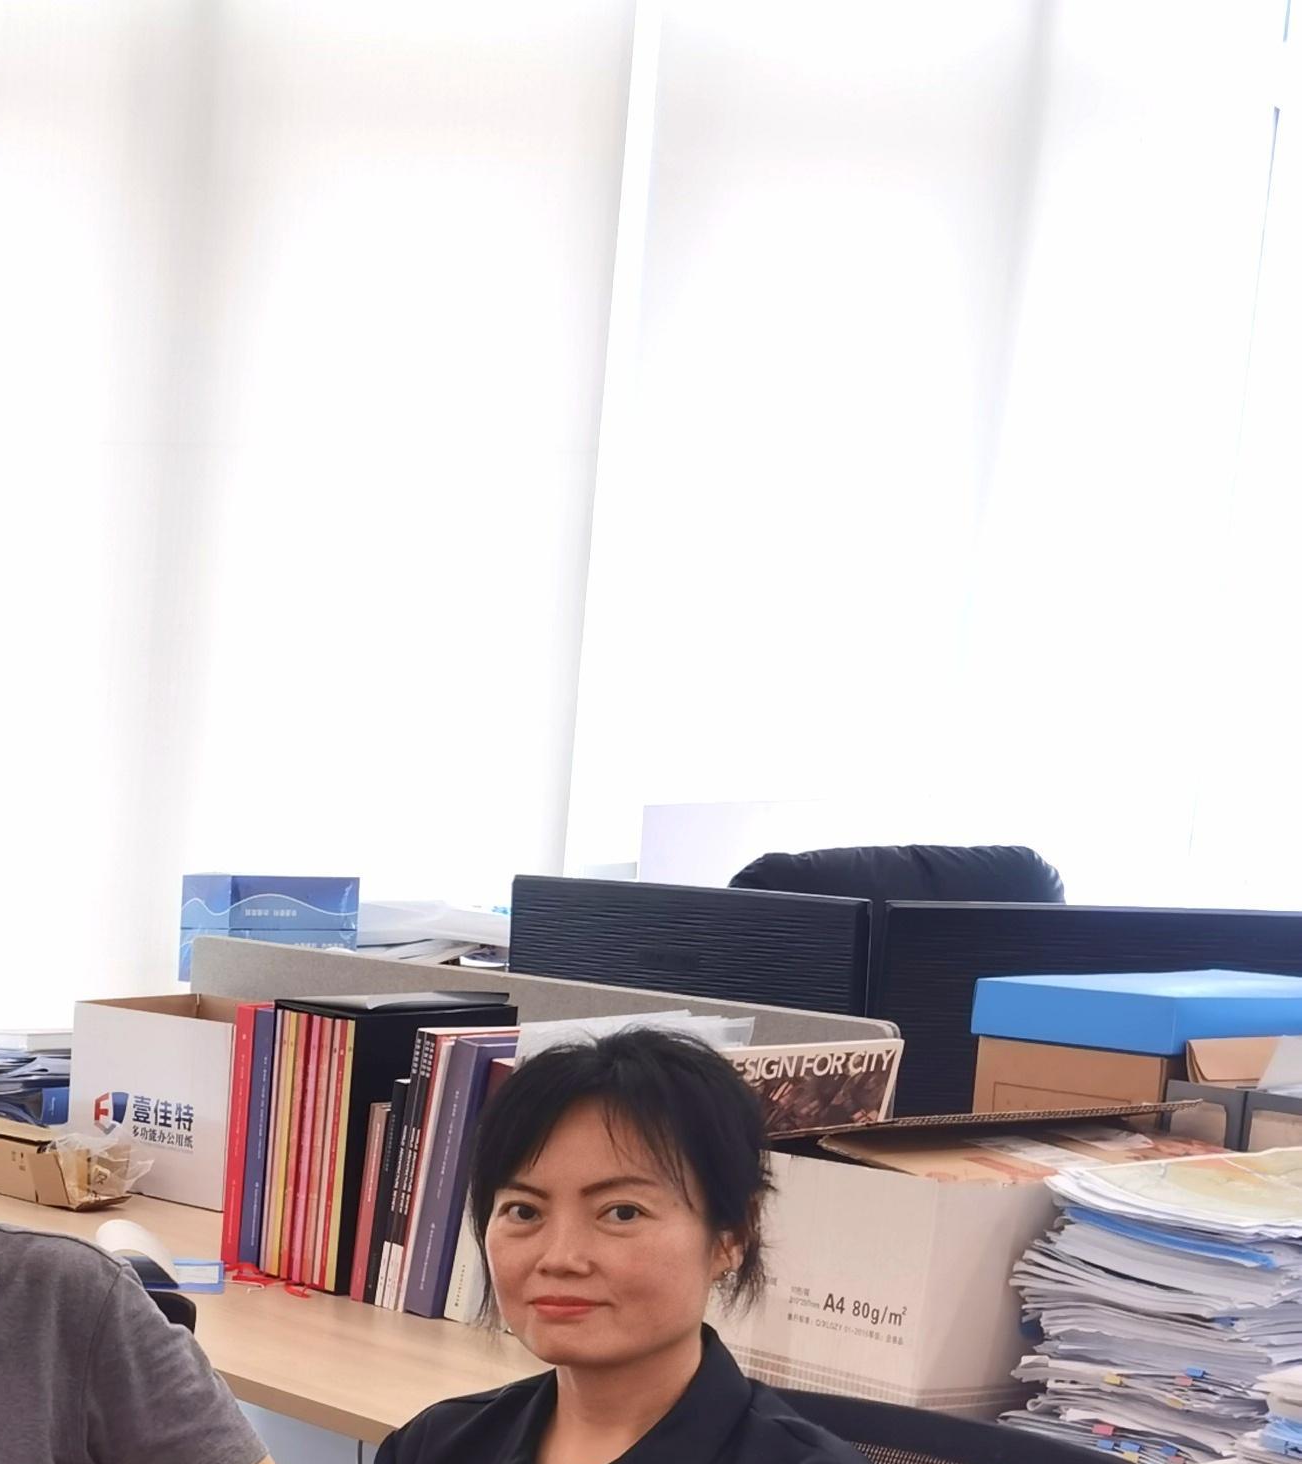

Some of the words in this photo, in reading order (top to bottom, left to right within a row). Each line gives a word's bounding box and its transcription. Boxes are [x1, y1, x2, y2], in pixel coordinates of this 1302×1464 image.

[733, 1055, 796, 1081] ESIGN
[800, 1053, 847, 1077] FOR
[849, 1049, 895, 1075] CITY
[132, 1095, 194, 1132] 壹佳特
[132, 1125, 194, 1149] 多功能办公用纸
[823, 1293, 846, 1314] A4
